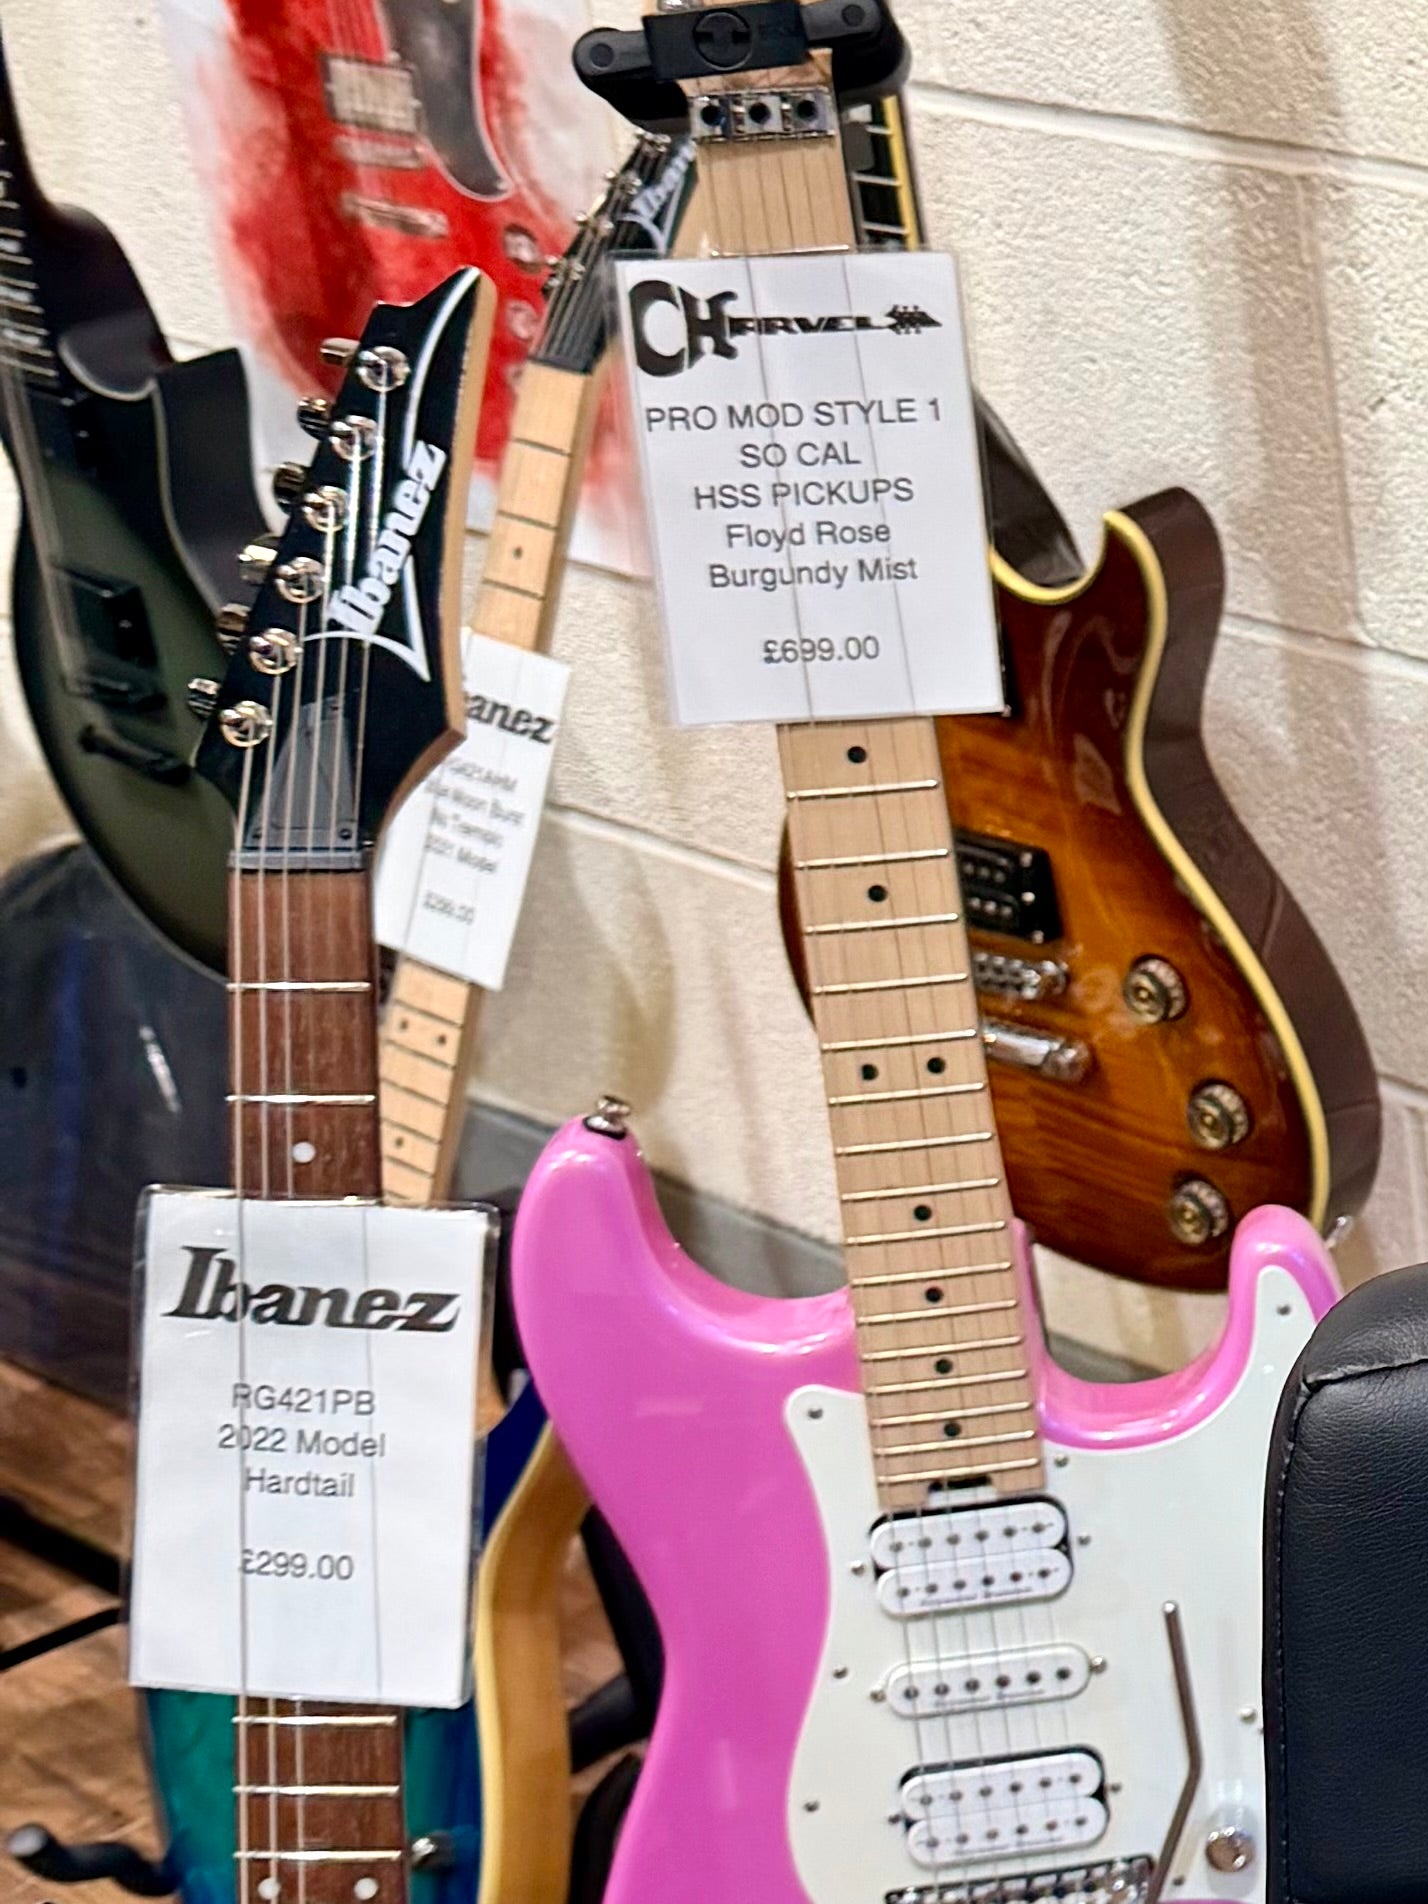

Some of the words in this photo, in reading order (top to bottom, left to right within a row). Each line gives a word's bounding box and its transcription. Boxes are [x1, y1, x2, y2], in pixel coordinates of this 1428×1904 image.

[645, 405, 717, 433] PRO
[728, 401, 803, 429] MOD
[813, 399, 917, 427] STYLE
[927, 397, 942, 422] 1
[739, 443, 787, 469] SO
[796, 441, 861, 467] CAL
[694, 483, 762, 510] HSS
[772, 477, 915, 508] PICKUPS
[329, 440, 447, 635] Ibanez
[726, 524, 806, 554] Floyd
[816, 522, 891, 546] Rose
[709, 560, 848, 592] Burgundy
[857, 557, 919, 583] Mist
[762, 636, 881, 664] £699.00
[465, 695, 557, 745] anez
[161, 1244, 462, 1333] Ibanez
[232, 1383, 375, 1417] RG421PB
[217, 1423, 287, 1452] 2022
[296, 1429, 386, 1457] Model
[244, 1467, 355, 1498] Hardtail
[240, 1548, 354, 1581] £299.00
